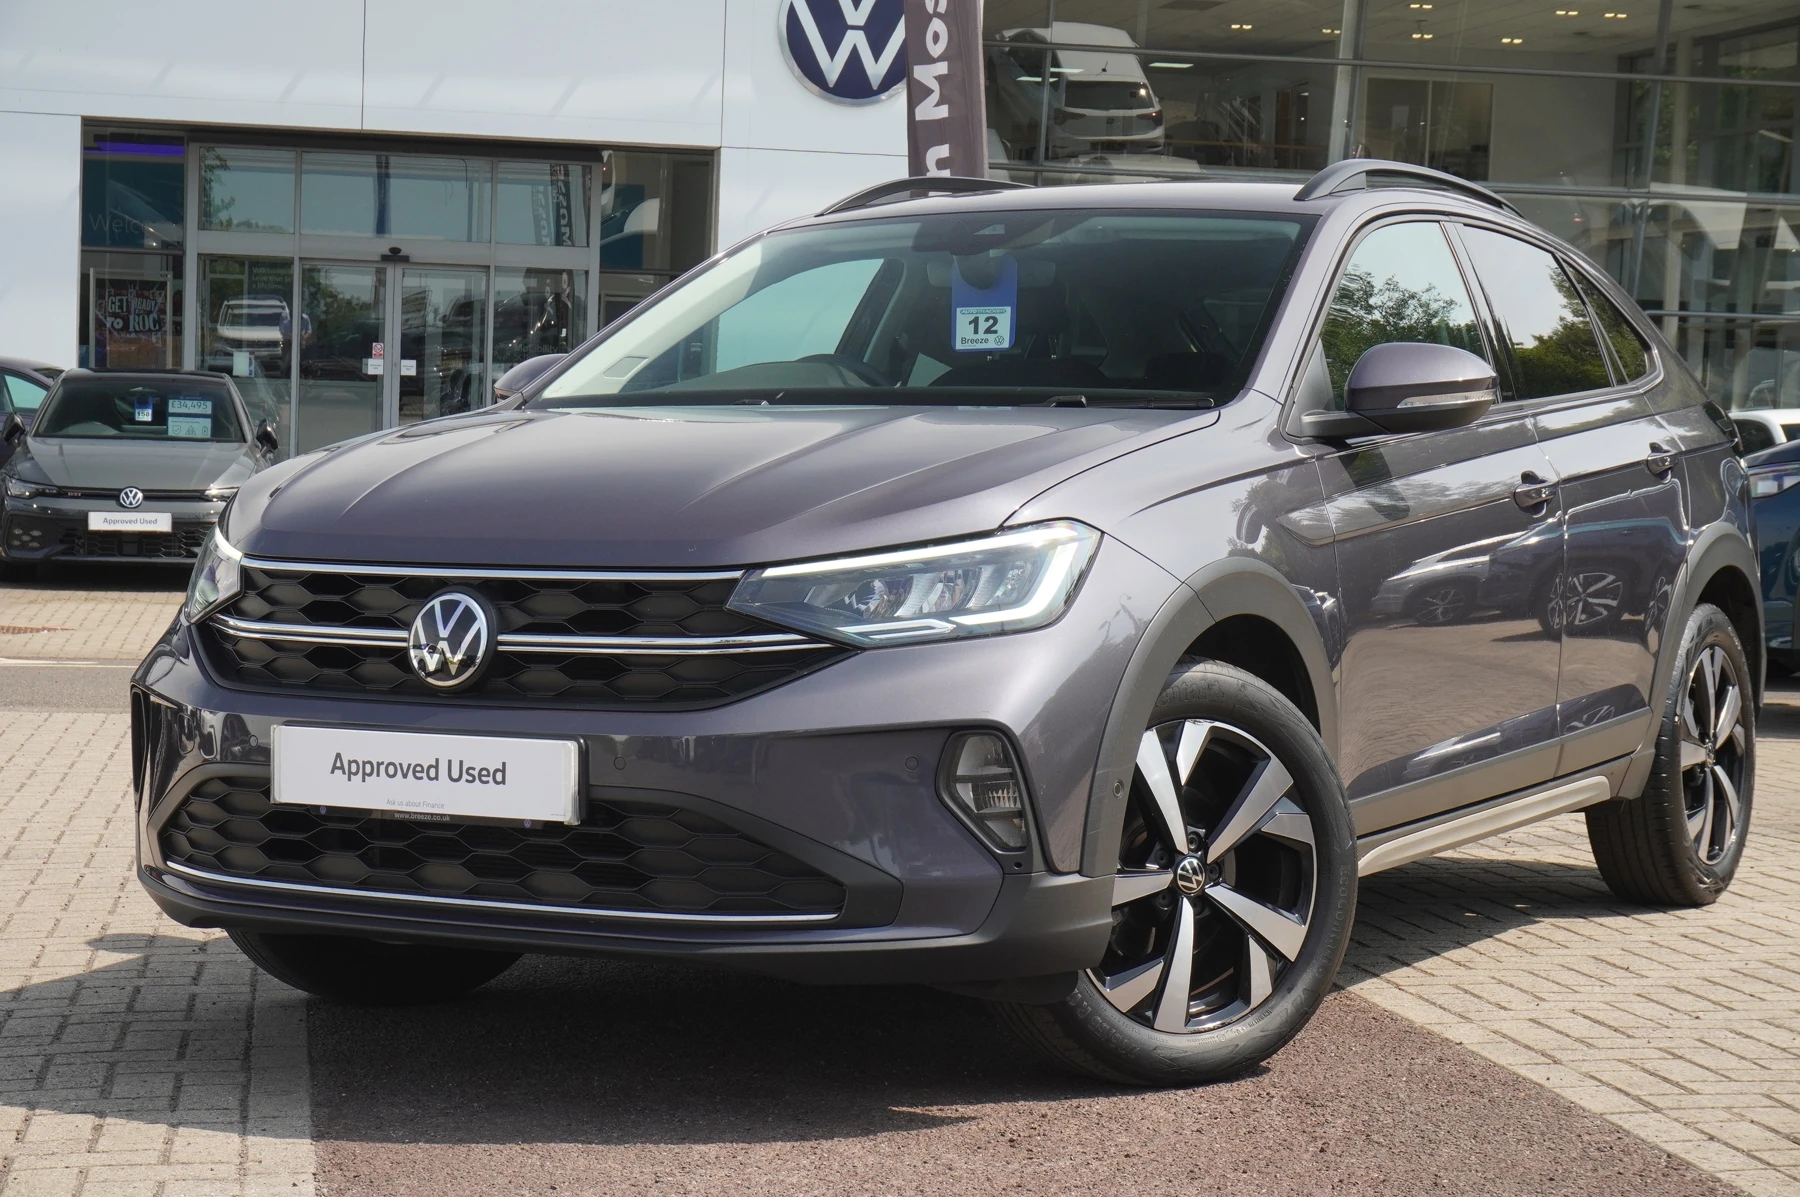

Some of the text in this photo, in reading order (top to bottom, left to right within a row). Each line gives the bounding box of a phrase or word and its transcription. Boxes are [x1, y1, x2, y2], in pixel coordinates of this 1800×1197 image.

[108, 296, 128, 313] GET
[968, 315, 999, 335] 12
[960, 336, 989, 344] Breeze
[171, 400, 208, 410] £34,495
[103, 517, 138, 525] Approved
[329, 751, 508, 786] Approved Used
[386, 798, 396, 806] Ask
[405, 800, 422, 808] about
[422, 801, 445, 809] Finance
[394, 812, 451, 822] www.breeze.co.uk
